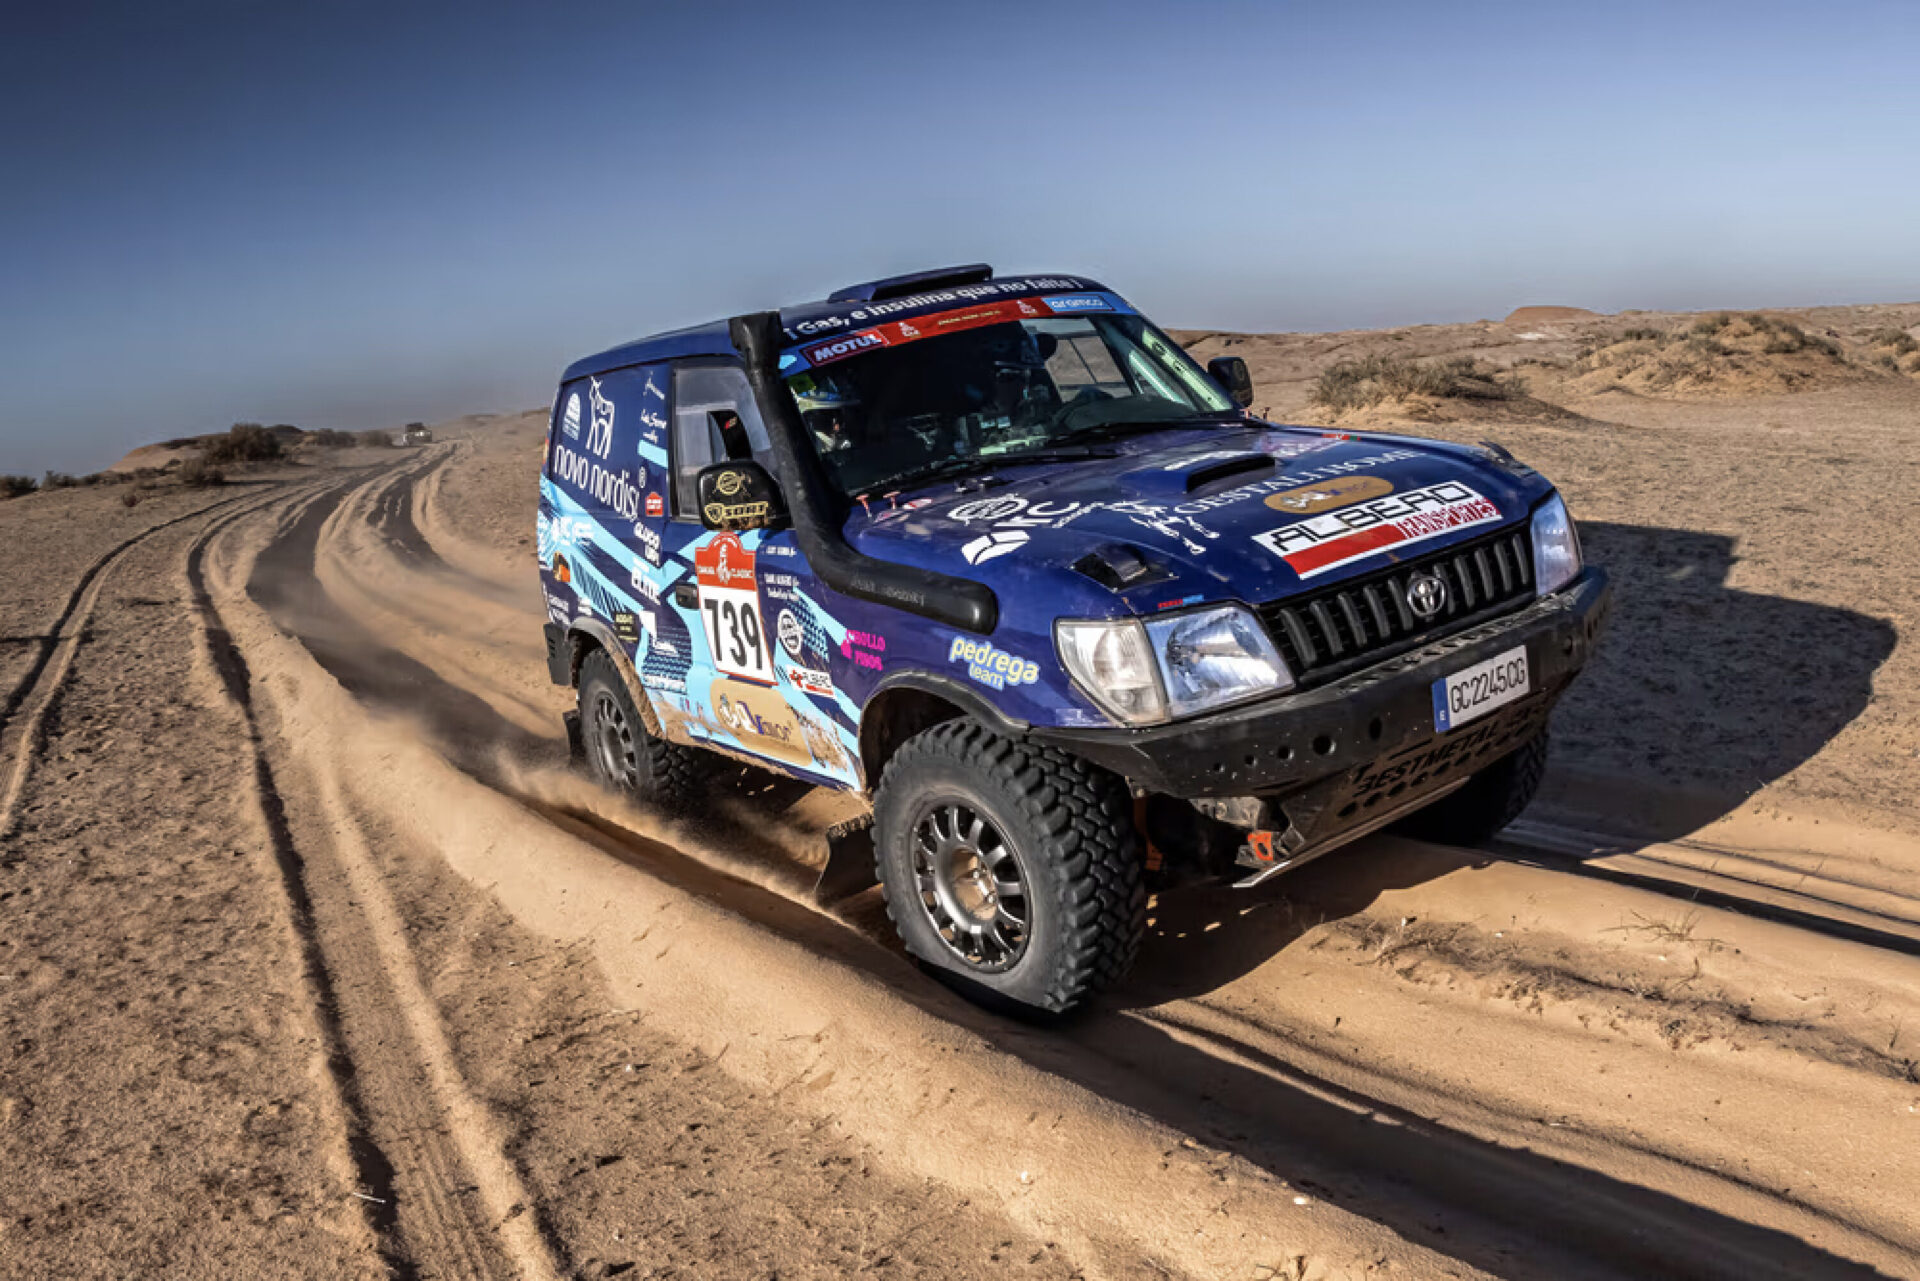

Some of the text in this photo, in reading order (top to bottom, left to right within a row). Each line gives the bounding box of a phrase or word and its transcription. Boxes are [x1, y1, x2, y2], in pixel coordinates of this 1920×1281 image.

[797, 316, 850, 334] Gas,
[851, 310, 868, 320] e
[865, 289, 957, 316] insulina
[956, 285, 999, 299] que
[999, 281, 1028, 293] no
[1051, 295, 1104, 308] aramco
[813, 333, 882, 361] MOTUL
[554, 445, 588, 490] novo
[1271, 483, 1473, 552] ALBERO
[704, 598, 763, 670] 739
[950, 638, 1039, 684] pedrega
[969, 663, 1004, 689] team
